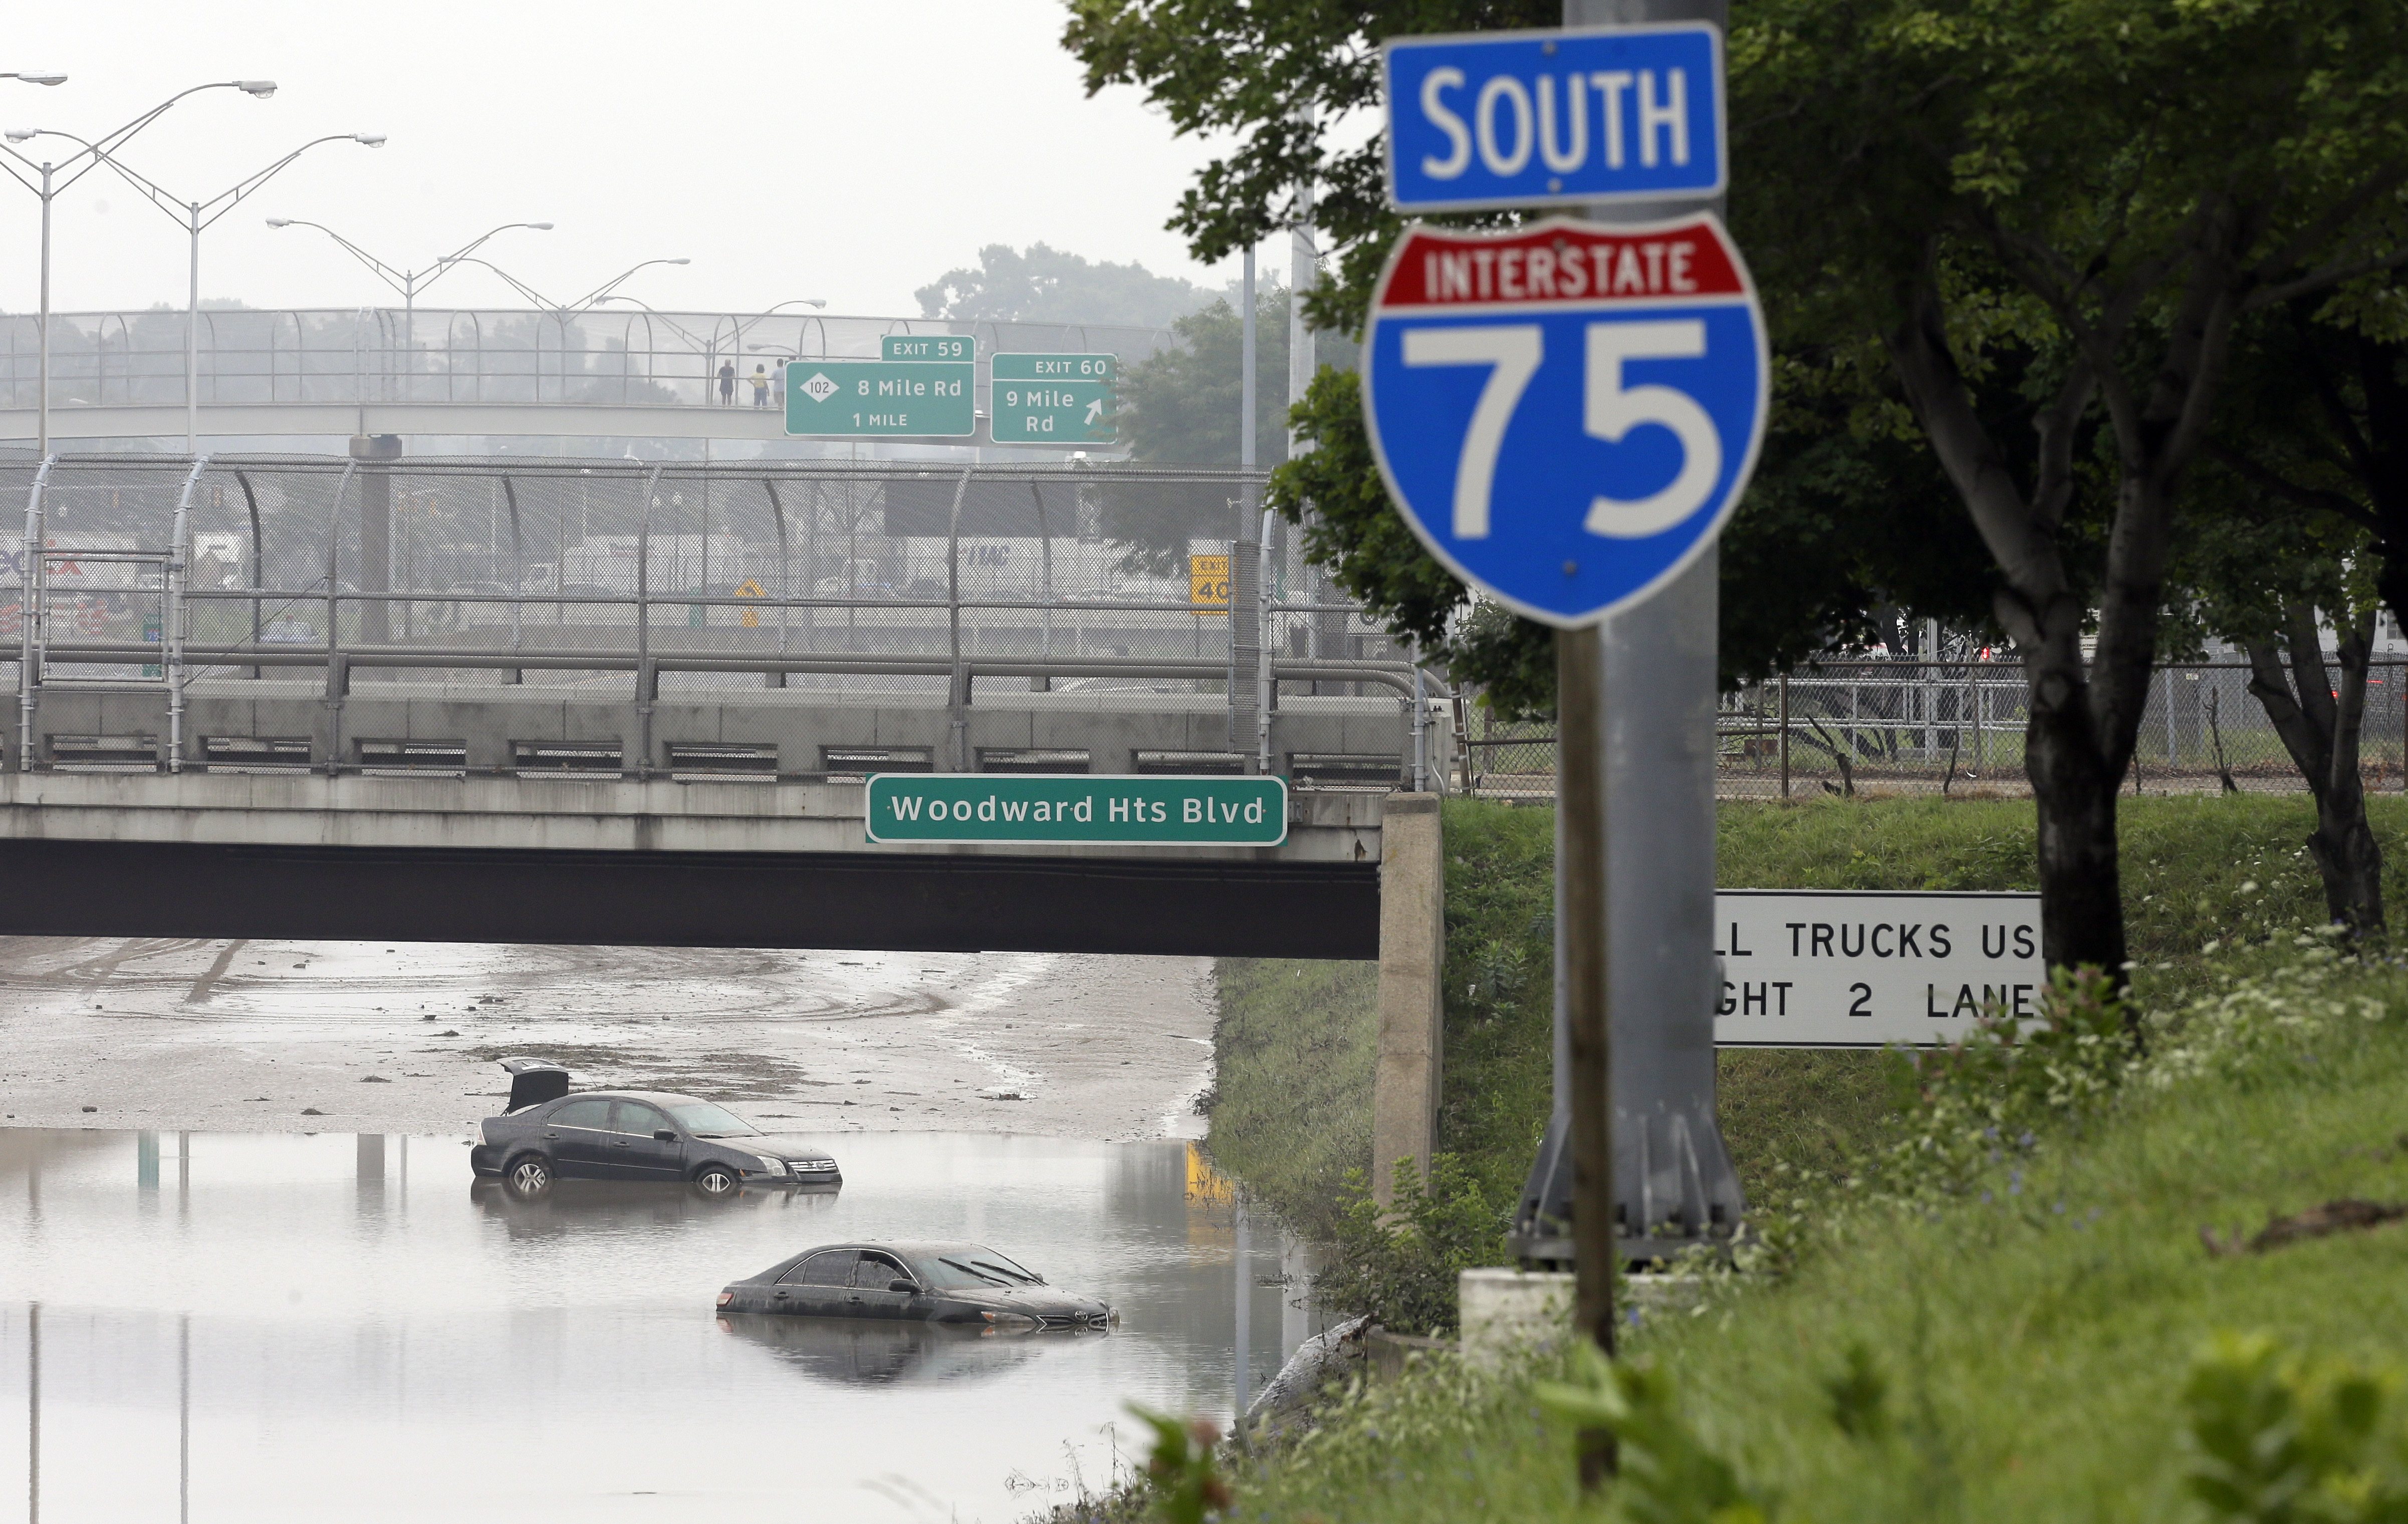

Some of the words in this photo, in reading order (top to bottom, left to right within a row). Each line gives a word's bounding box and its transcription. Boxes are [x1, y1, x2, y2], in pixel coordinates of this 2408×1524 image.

[1420, 67, 1689, 180] SOUTH
[1425, 242, 1697, 301] INTERSTATE
[893, 343, 928, 355] EXIT
[938, 342, 962, 357] 59
[1036, 361, 1072, 374] EXIT
[1080, 360, 1107, 375] 60
[810, 381, 829, 394] 102
[858, 380, 869, 396] 8
[879, 379, 925, 396] Mile
[934, 379, 961, 396] Rd
[1006, 391, 1018, 407] 9
[1027, 390, 1074, 407] Mile
[853, 413, 860, 427] 1
[869, 414, 907, 426] MILE
[1027, 415, 1054, 432] Rd
[1401, 319, 1723, 540] 75
[1198, 582, 1230, 599] 40
[891, 795, 1092, 822] Woodward
[1109, 797, 1167, 823] Hts
[1183, 797, 1263, 824] Blvd
[1786, 923, 1952, 958] TRUCKS
[1982, 924, 2044, 959] US
[1849, 982, 1872, 1017] 2
[1928, 983, 2035, 1019] LANE
